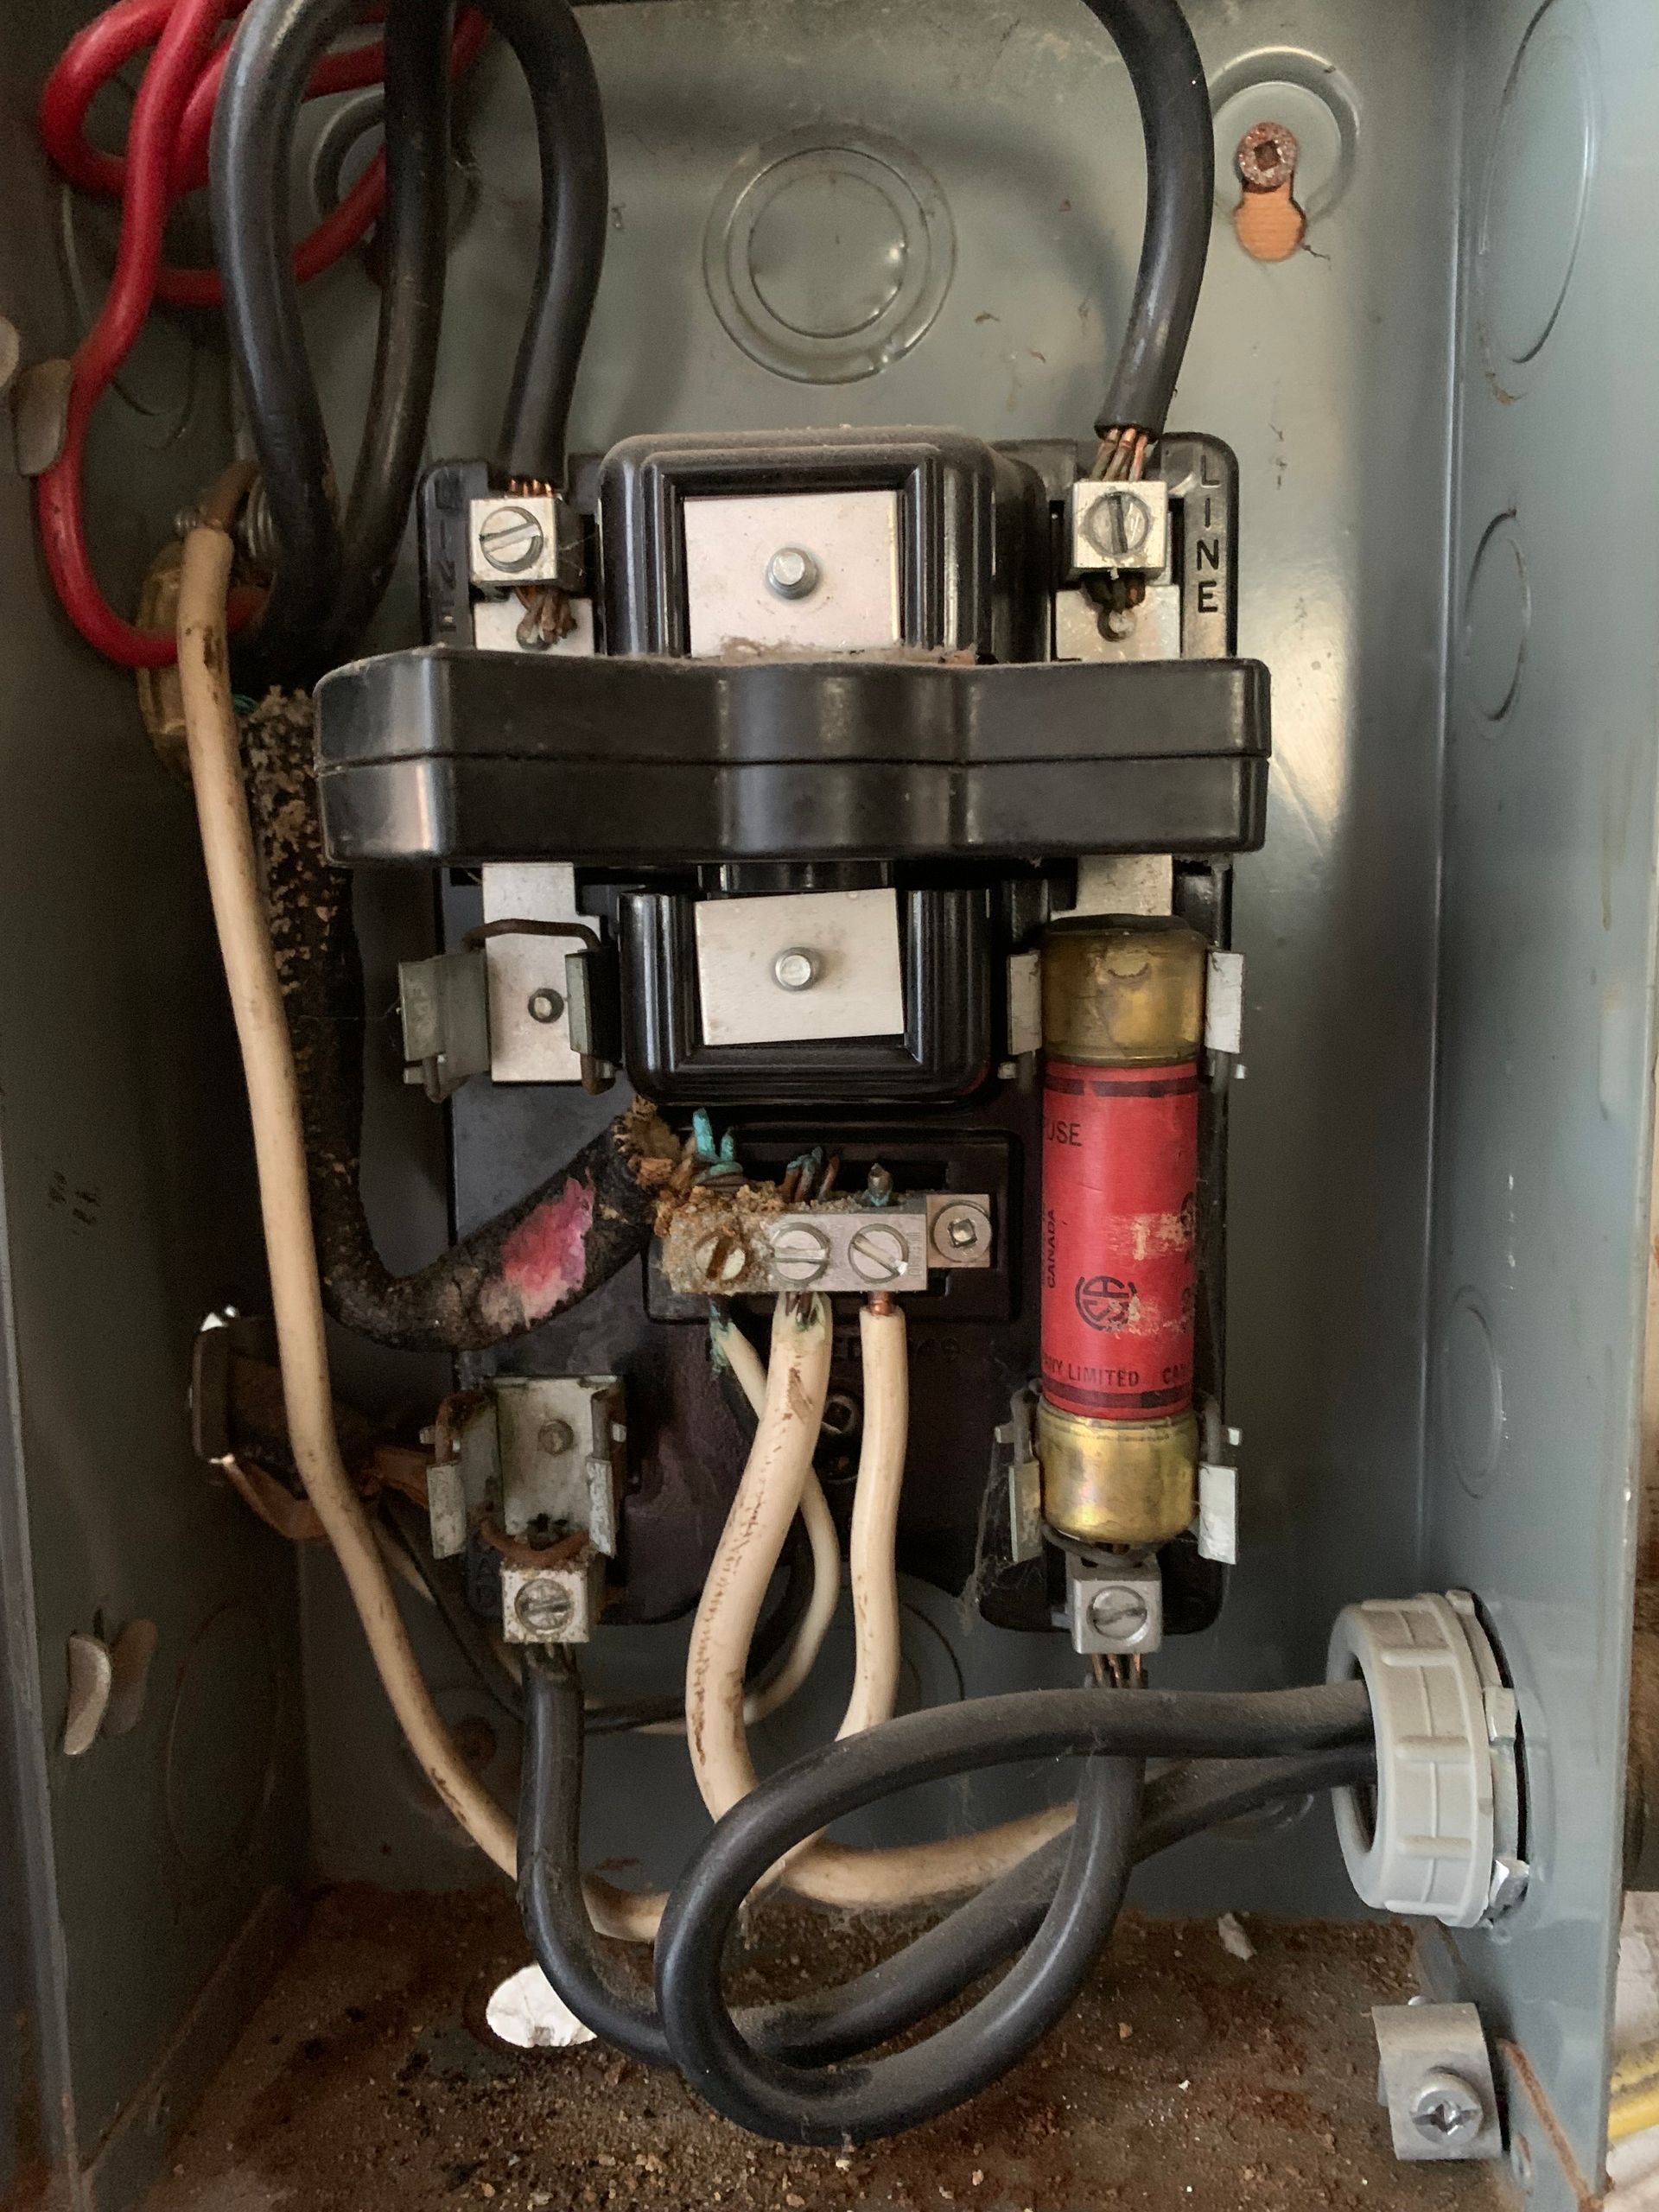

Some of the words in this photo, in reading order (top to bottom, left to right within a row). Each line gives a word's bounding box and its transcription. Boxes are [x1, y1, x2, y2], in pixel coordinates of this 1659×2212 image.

[1196, 454, 1221, 613] LINE
[1047, 1209, 1056, 1289] CANADA
[1068, 1363, 1140, 1388] LIMITED
